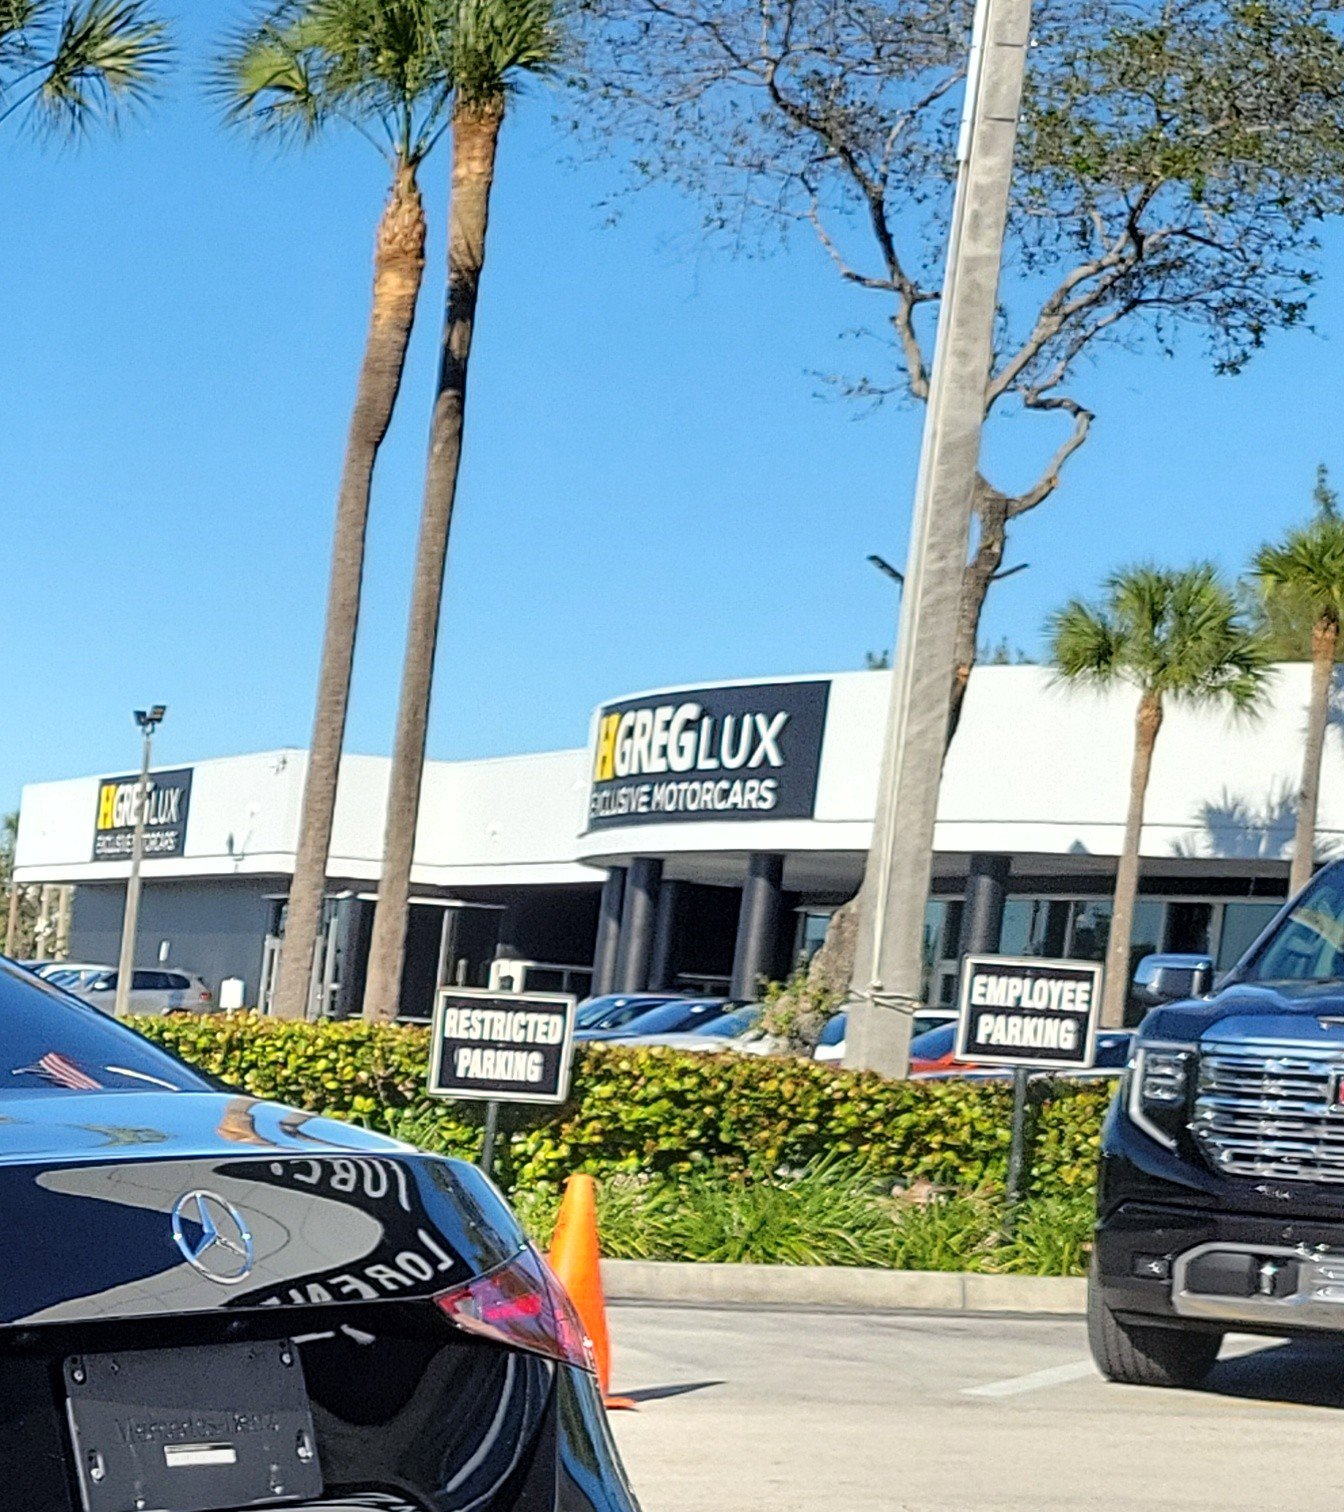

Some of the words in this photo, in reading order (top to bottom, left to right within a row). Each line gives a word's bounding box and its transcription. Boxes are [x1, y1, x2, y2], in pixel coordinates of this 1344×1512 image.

[651, 778, 778, 812] MOTORCARS
[971, 973, 1091, 1012] EMPLOYEE
[444, 1006, 564, 1045] RESTRICTED
[975, 1013, 1079, 1050] PARKING
[455, 1047, 545, 1083] PARKING
